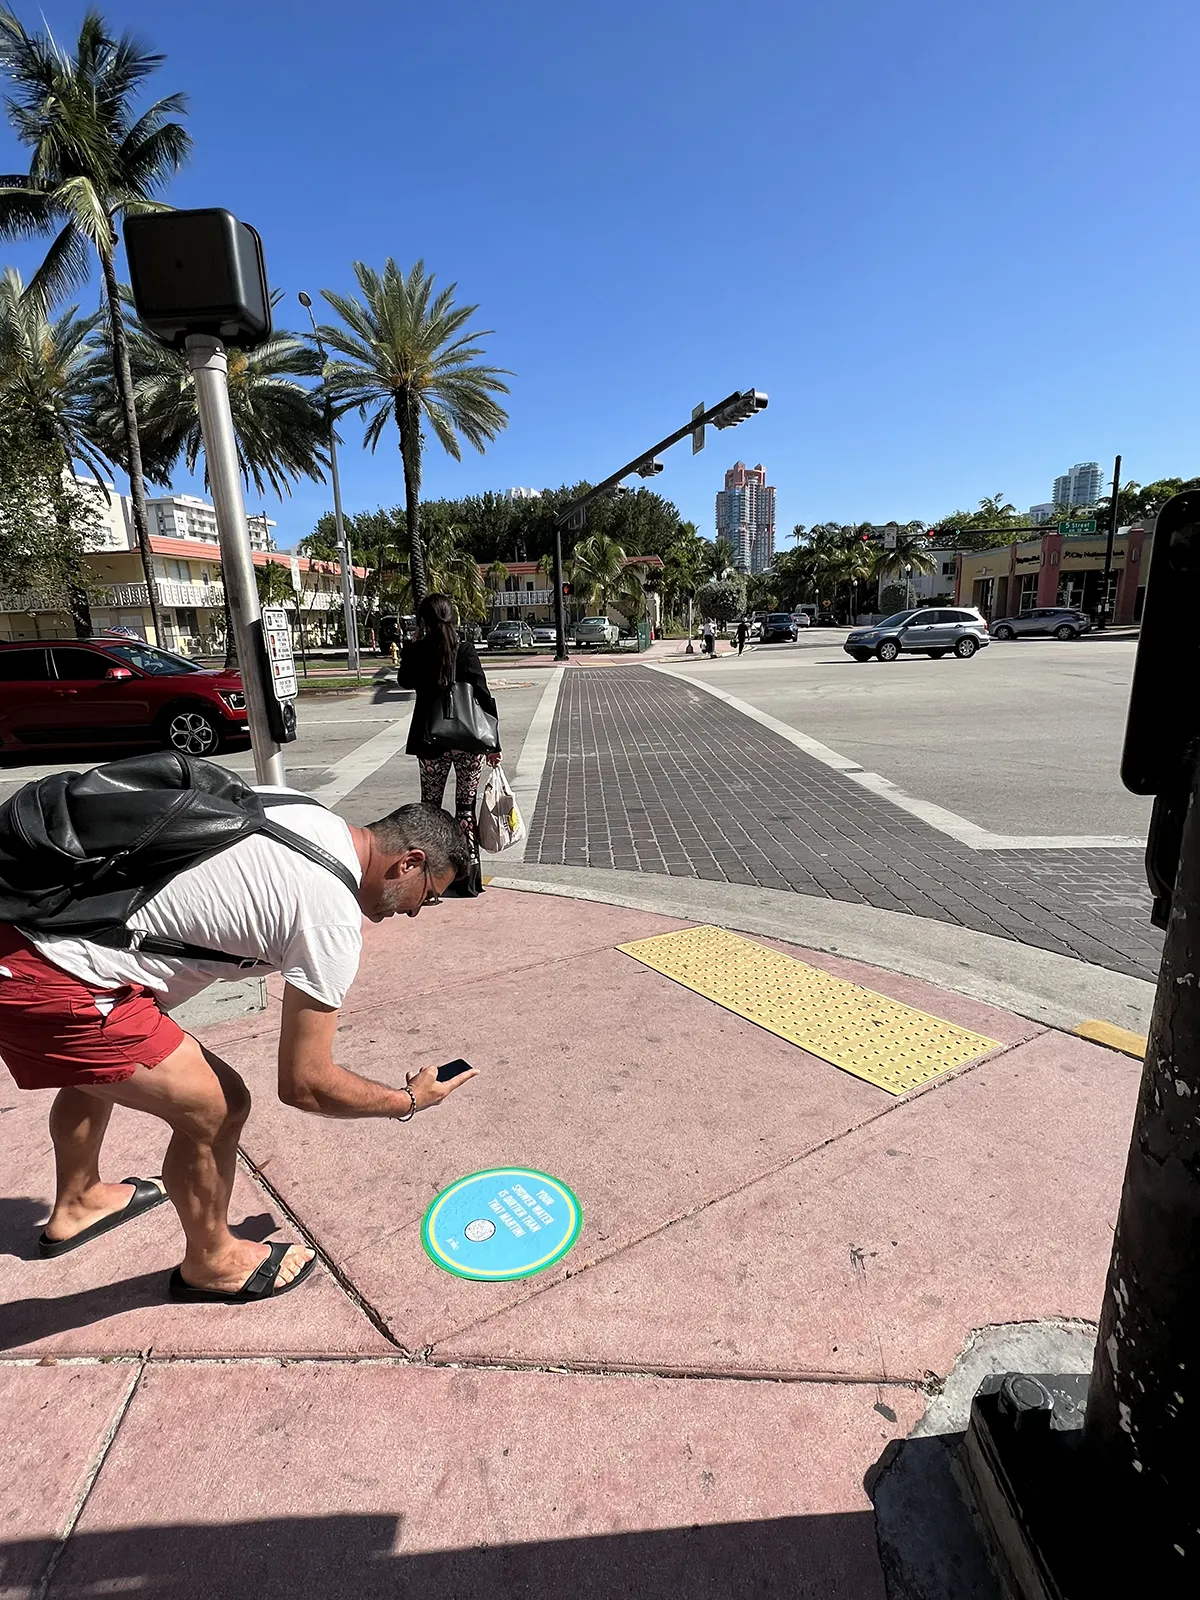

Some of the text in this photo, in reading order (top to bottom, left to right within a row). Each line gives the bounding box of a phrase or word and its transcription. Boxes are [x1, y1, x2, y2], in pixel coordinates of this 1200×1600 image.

[497, 1189, 542, 1233] IS DIRTIER THAN
[511, 1184, 555, 1225] SHOWER WATER
[536, 1189, 555, 1206] YOUR
[487, 1198, 526, 1238] THAT MARTINI
